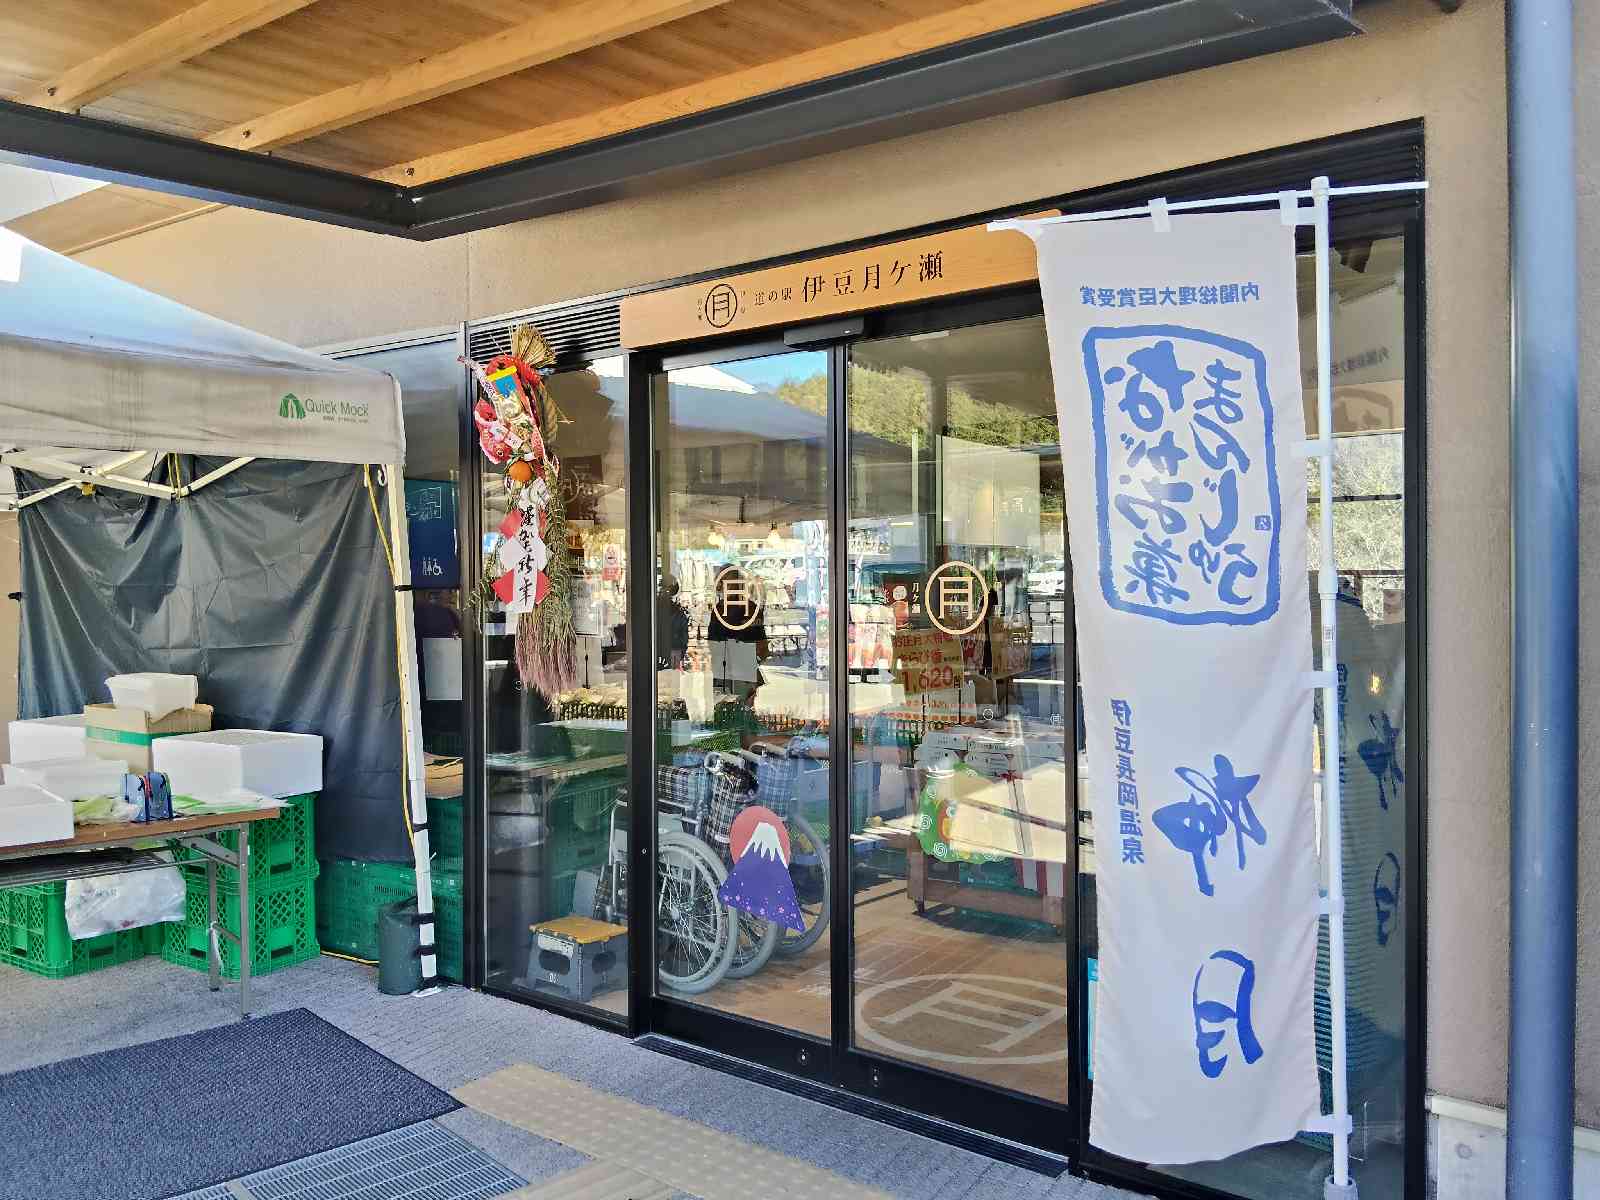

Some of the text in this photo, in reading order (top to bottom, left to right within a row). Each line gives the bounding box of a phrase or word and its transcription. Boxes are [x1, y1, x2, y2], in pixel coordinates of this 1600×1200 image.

[754, 287, 792, 306] 道の駅
[305, 398, 338, 415] Quick
